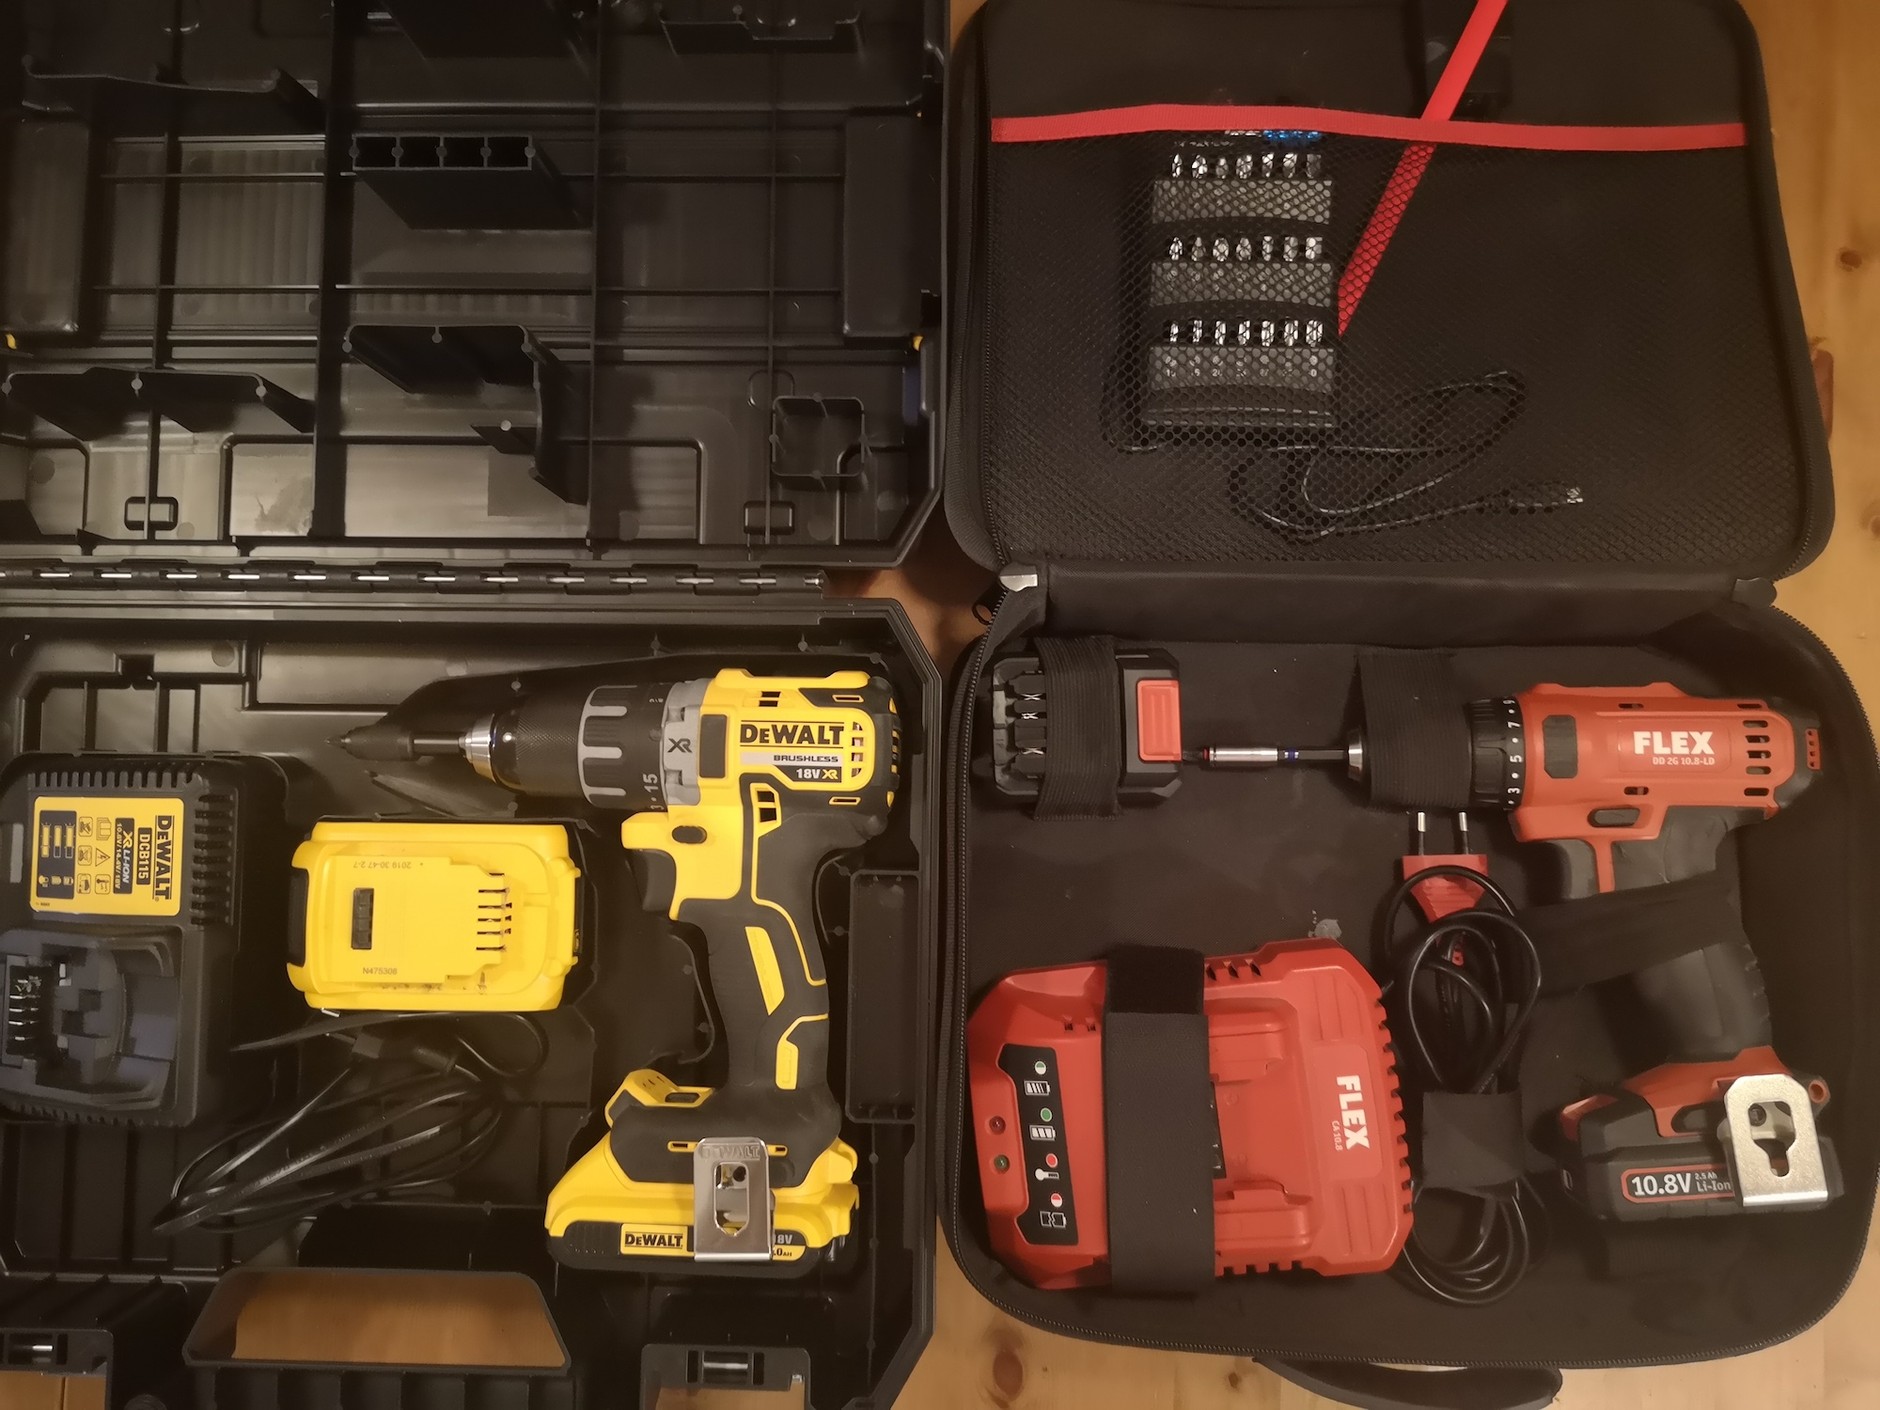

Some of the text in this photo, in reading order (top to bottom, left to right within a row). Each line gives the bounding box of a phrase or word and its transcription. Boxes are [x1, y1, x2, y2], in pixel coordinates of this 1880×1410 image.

[739, 723, 844, 745] DEWALT
[1633, 731, 1715, 755] FLEX
[667, 737, 693, 753] XR
[773, 754, 839, 763] BRUSHLESS
[1510, 755, 1523, 763] 5
[1652, 757, 1665, 765] DD
[1681, 757, 1715, 765] 10.8-LD
[642, 773, 658, 793] 15
[796, 768, 838, 780] 18V XR
[122, 831, 134, 884] XR LI-ION
[138, 834, 151, 879] DCB115
[155, 815, 173, 900] DEWALT
[1336, 1075, 1370, 1150] FLEX
[1333, 1133, 1343, 1151] 10.8
[1631, 1173, 1692, 1196] 10.8V
[1696, 1181, 1731, 1193] Li-Ion
[625, 1234, 683, 1247] DEWALT
[774, 1234, 793, 1244] 8V
